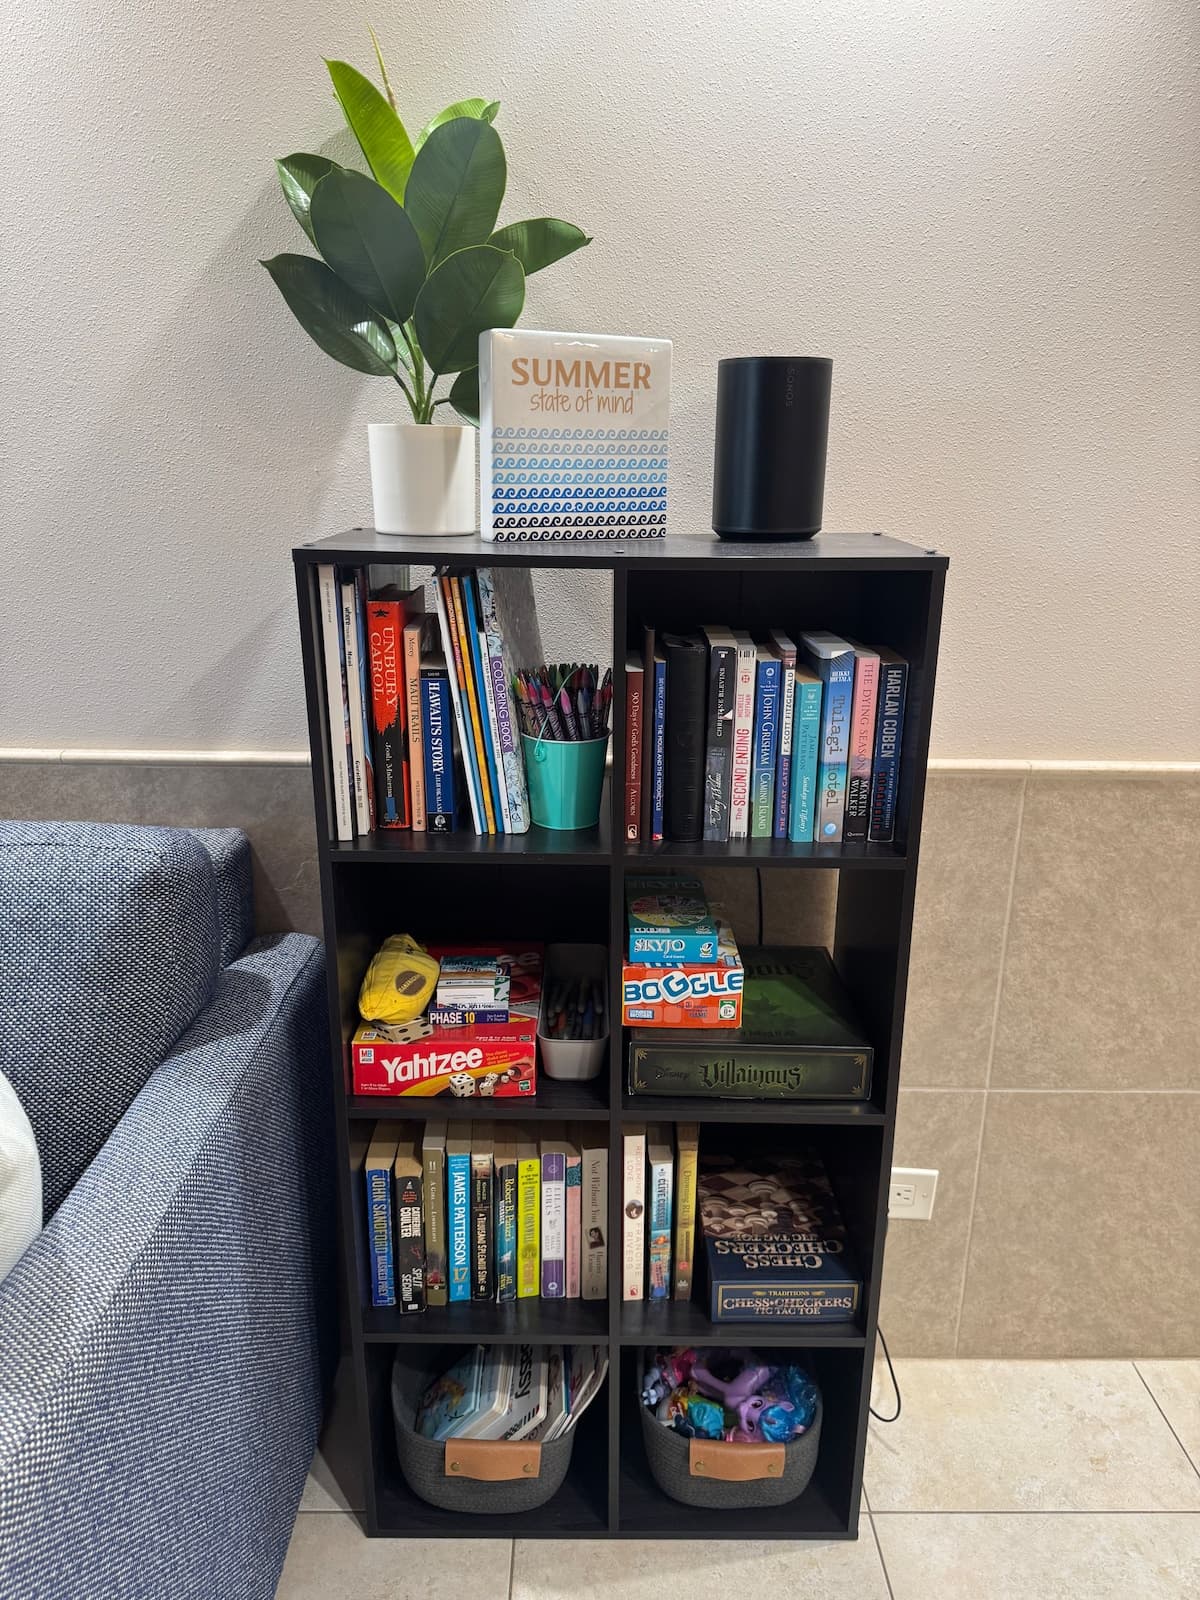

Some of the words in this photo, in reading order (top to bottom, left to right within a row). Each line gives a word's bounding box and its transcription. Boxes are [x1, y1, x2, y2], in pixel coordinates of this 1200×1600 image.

[511, 357, 652, 390] SUMMER
[786, 368, 796, 407] SONOS
[530, 388, 571, 411] state
[576, 389, 593, 414] of
[597, 390, 634, 415] mind
[370, 632, 384, 701] CAROL
[382, 626, 397, 706] UNBURY
[863, 663, 873, 685] THE
[410, 677, 419, 704] MAUI
[492, 660, 509, 718] COLORING
[718, 667, 726, 697] BLEVINS
[785, 672, 794, 719] FITZGERALD
[884, 669, 902, 716] HARLAN
[428, 682, 442, 735] HAWAII'S
[632, 691, 640, 704] 90
[763, 694, 776, 720] JOHN
[860, 689, 872, 725] DYING
[411, 711, 420, 743] TRAILS
[630, 705, 640, 722] Days
[826, 695, 846, 755] Tulagi
[500, 720, 512, 749] BOOK
[631, 728, 639, 747] God's
[736, 728, 750, 764] ENDING
[760, 722, 774, 765] GRISHAM
[783, 744, 789, 753] F.
[800, 721, 809, 770] PATTERSON
[807, 734, 815, 759] JAMES
[881, 719, 898, 758] COBEN
[384, 742, 393, 761] Josh
[431, 739, 444, 774] STORY
[630, 748, 639, 779] Goodness
[857, 729, 869, 770] SEASON
[733, 767, 748, 806] SECOND
[759, 772, 771, 803] CAMINO
[825, 761, 842, 808] Hotel
[849, 780, 859, 817] WALKER
[858, 780, 869, 817] MARTIN
[758, 803, 770, 830] ISLAND
[780, 790, 788, 815] GREAT
[634, 938, 686, 953] SKYJO
[624, 972, 743, 1002] BOGGLE
[429, 1011, 462, 1024] PHASE
[464, 1012, 475, 1023] 10
[361, 1049, 373, 1058] MB
[380, 1048, 483, 1084] Yahtzee
[653, 1066, 689, 1080] Disney
[698, 1059, 802, 1091] Villainous
[591, 1160, 600, 1176] Not
[634, 1145, 642, 1196] REDEEMING
[372, 1175, 386, 1202] JOHN
[452, 1171, 466, 1205] JAMES
[505, 1178, 514, 1204] Robert
[524, 1186, 535, 1212] PATRICIA
[591, 1176, 600, 1203] Without
[658, 1178, 666, 1198] CLIVE
[400, 1207, 412, 1239] COULTER
[411, 1207, 421, 1238] CATHERINE
[506, 1204, 514, 1214] B.
[591, 1204, 600, 1223] You
[372, 1203, 388, 1254] SANDFORD
[454, 1206, 466, 1265] PATTERSON
[476, 1217, 486, 1245] THOUSAND
[505, 1214, 514, 1242] Parker's
[765, 1234, 791, 1242] TAC
[792, 1233, 818, 1242] TIC
[477, 1245, 487, 1269] SPLENDID
[714, 1239, 844, 1254] CHECKERS
[453, 1267, 468, 1283] 17
[742, 1254, 823, 1269] CHESS
[378, 1281, 388, 1297] PREY
[402, 1273, 413, 1302] SECOND
[412, 1268, 423, 1289] SPLIT
[477, 1270, 487, 1284] SUNS
[723, 1298, 770, 1309] CHESS
[775, 1296, 852, 1309] CHECKERS
[755, 1307, 773, 1315] TIC
[775, 1307, 796, 1315] TAC
[798, 1307, 821, 1315] TOE
